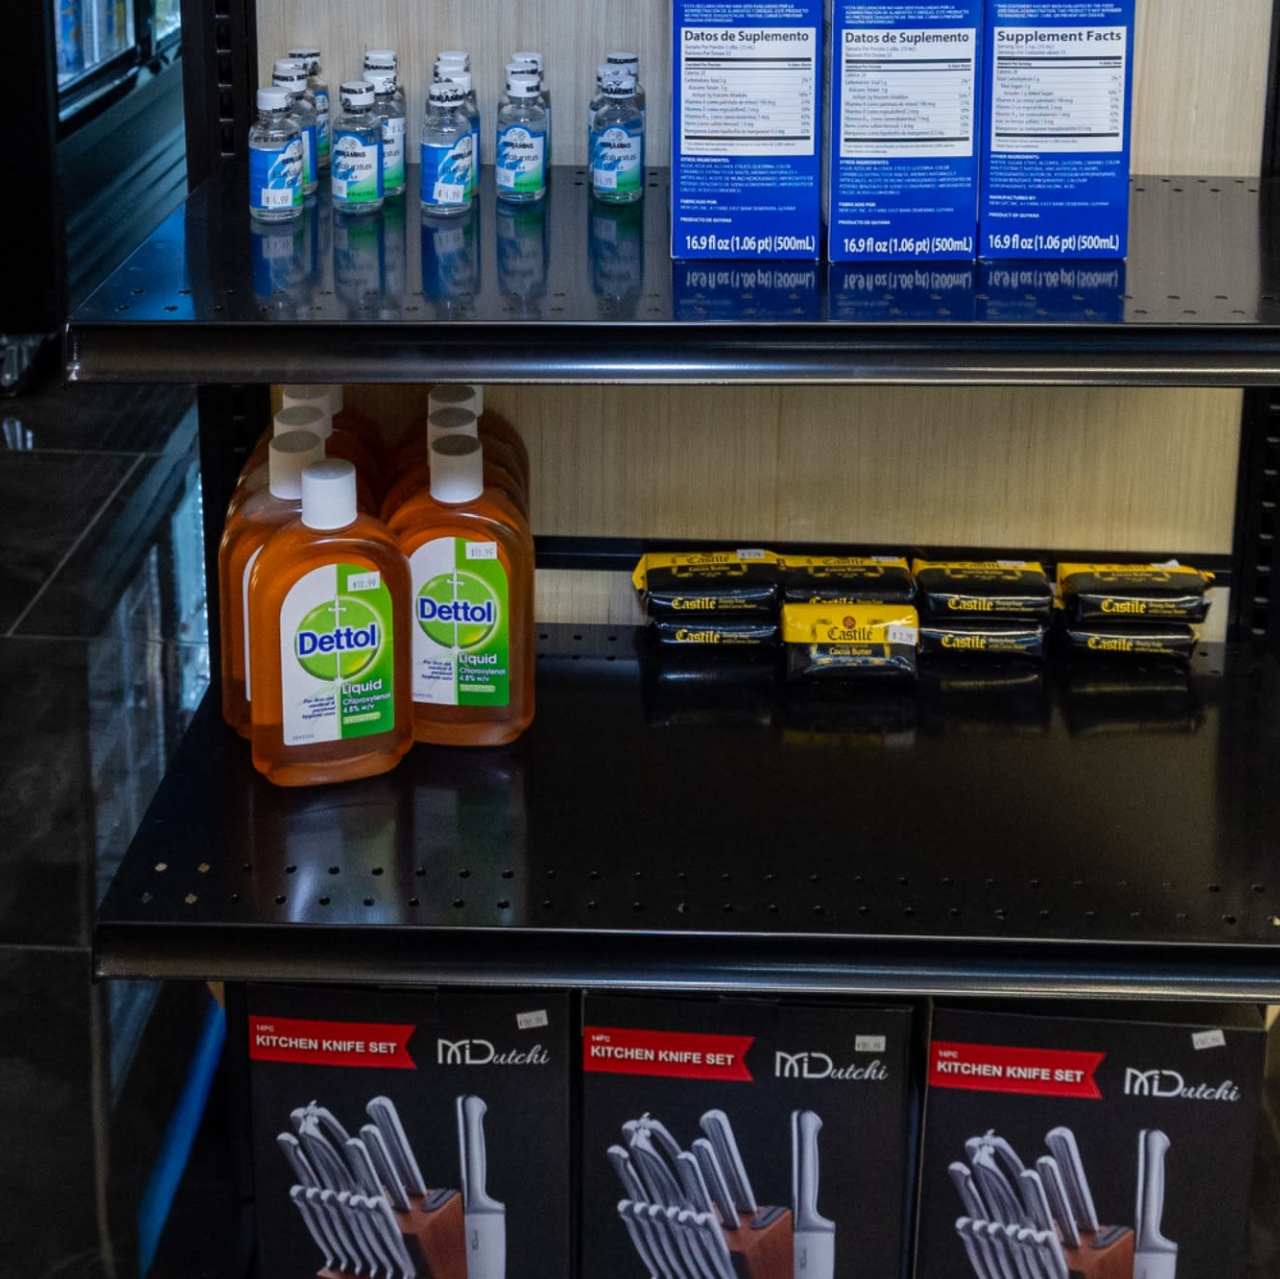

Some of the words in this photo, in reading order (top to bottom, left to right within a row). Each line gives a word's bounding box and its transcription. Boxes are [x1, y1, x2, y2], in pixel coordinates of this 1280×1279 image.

[685, 31, 718, 41] Datos
[721, 31, 735, 41] de
[738, 30, 809, 43] Suplemento
[845, 33, 879, 43] Datos
[882, 33, 897, 42] de
[900, 32, 969, 45] Suplemento
[997, 31, 1083, 44] Supplement
[1087, 30, 1122, 41] Facts
[686, 236, 708, 250] 16.9
[709, 235, 715, 250] fl
[718, 239, 730, 250] oz
[731, 236, 756, 252] (1.06
[757, 236, 772, 254] pt)
[774, 236, 815, 252] (500mL)
[844, 238, 866, 252] 16.9
[867, 238, 873, 252] fl
[875, 242, 888, 252] oz
[889, 238, 914, 254] (1.06
[915, 238, 929, 255] pt)
[932, 237, 972, 253] (500mL)
[989, 235, 1011, 249] 16.9
[1012, 234, 1019, 249] fl
[1021, 239, 1033, 249] oz
[1035, 236, 1060, 251] (1.06
[1061, 235, 1076, 252] pt)
[1078, 235, 1119, 251] (500mL)
[420, 599, 492, 622] Dettol
[672, 597, 717, 610] Castile
[948, 598, 994, 612] Castile
[1101, 598, 1146, 614] Castile
[299, 624, 376, 655] Dettol
[676, 629, 720, 644] Castile
[828, 626, 873, 642] Castile
[941, 634, 987, 649] Castile
[1088, 636, 1132, 652] Castile
[459, 654, 497, 665] Liquid
[342, 679, 382, 695] Liquid
[256, 1035, 319, 1050] KITCHEN
[322, 1040, 366, 1052] KNIFE
[369, 1043, 397, 1054] SET
[590, 1046, 655, 1061] KITCHEN
[658, 1051, 701, 1064] KNIFE
[705, 1054, 735, 1066] SET
[937, 1061, 1003, 1077] KITCHEN
[1006, 1066, 1050, 1080] KNIFE
[1054, 1069, 1084, 1082] SET
